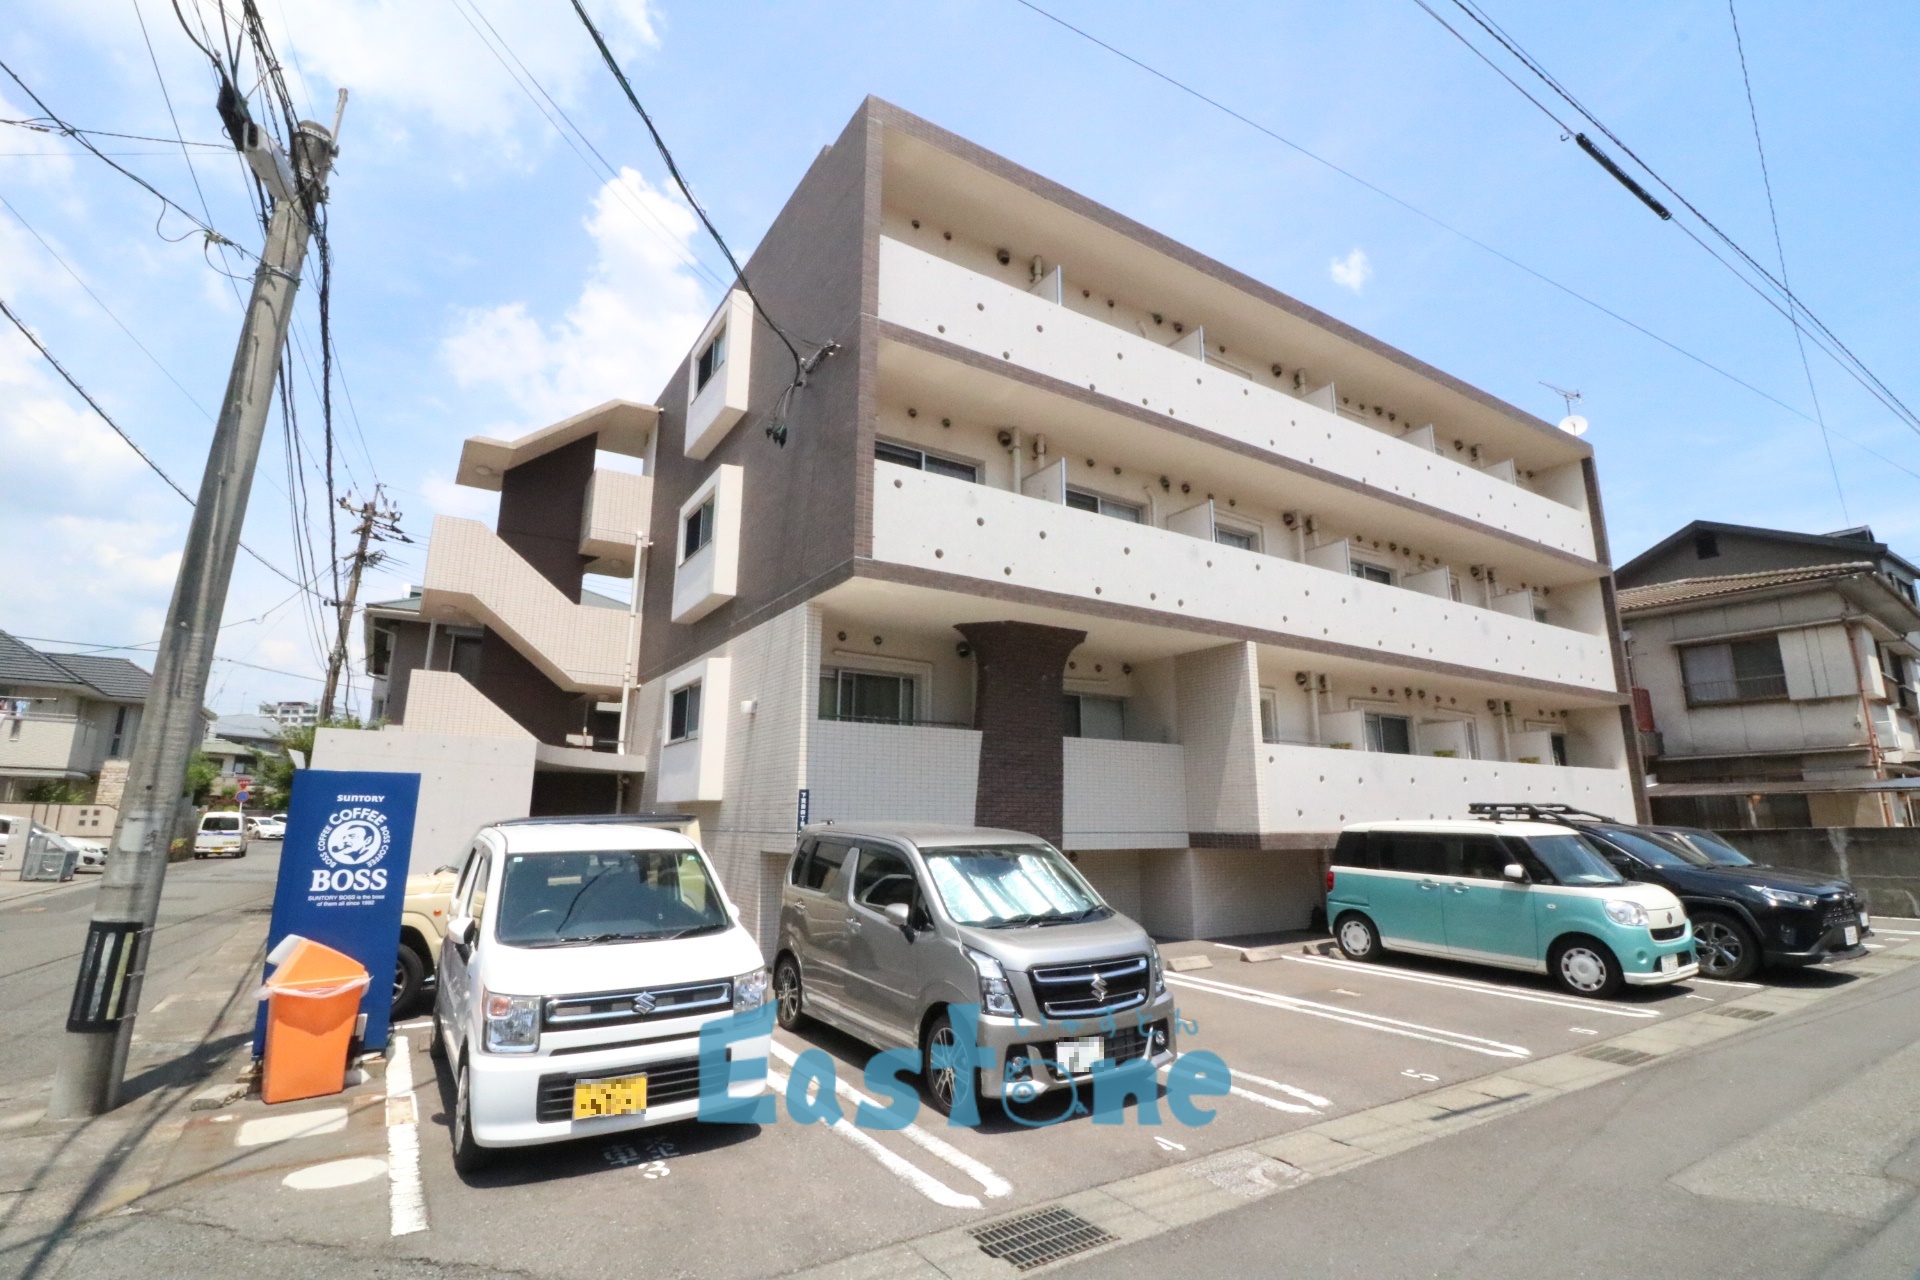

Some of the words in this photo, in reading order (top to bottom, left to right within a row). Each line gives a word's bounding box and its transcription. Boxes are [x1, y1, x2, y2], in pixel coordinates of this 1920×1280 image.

[329, 807, 387, 826] COFFEE
[318, 825, 332, 851] COFFEE
[381, 825, 391, 843] BOSS
[320, 851, 337, 868] BOSS
[366, 844, 389, 868] COFFEE
[309, 869, 388, 891] BOSS
[637, 1160, 671, 1179] 3
